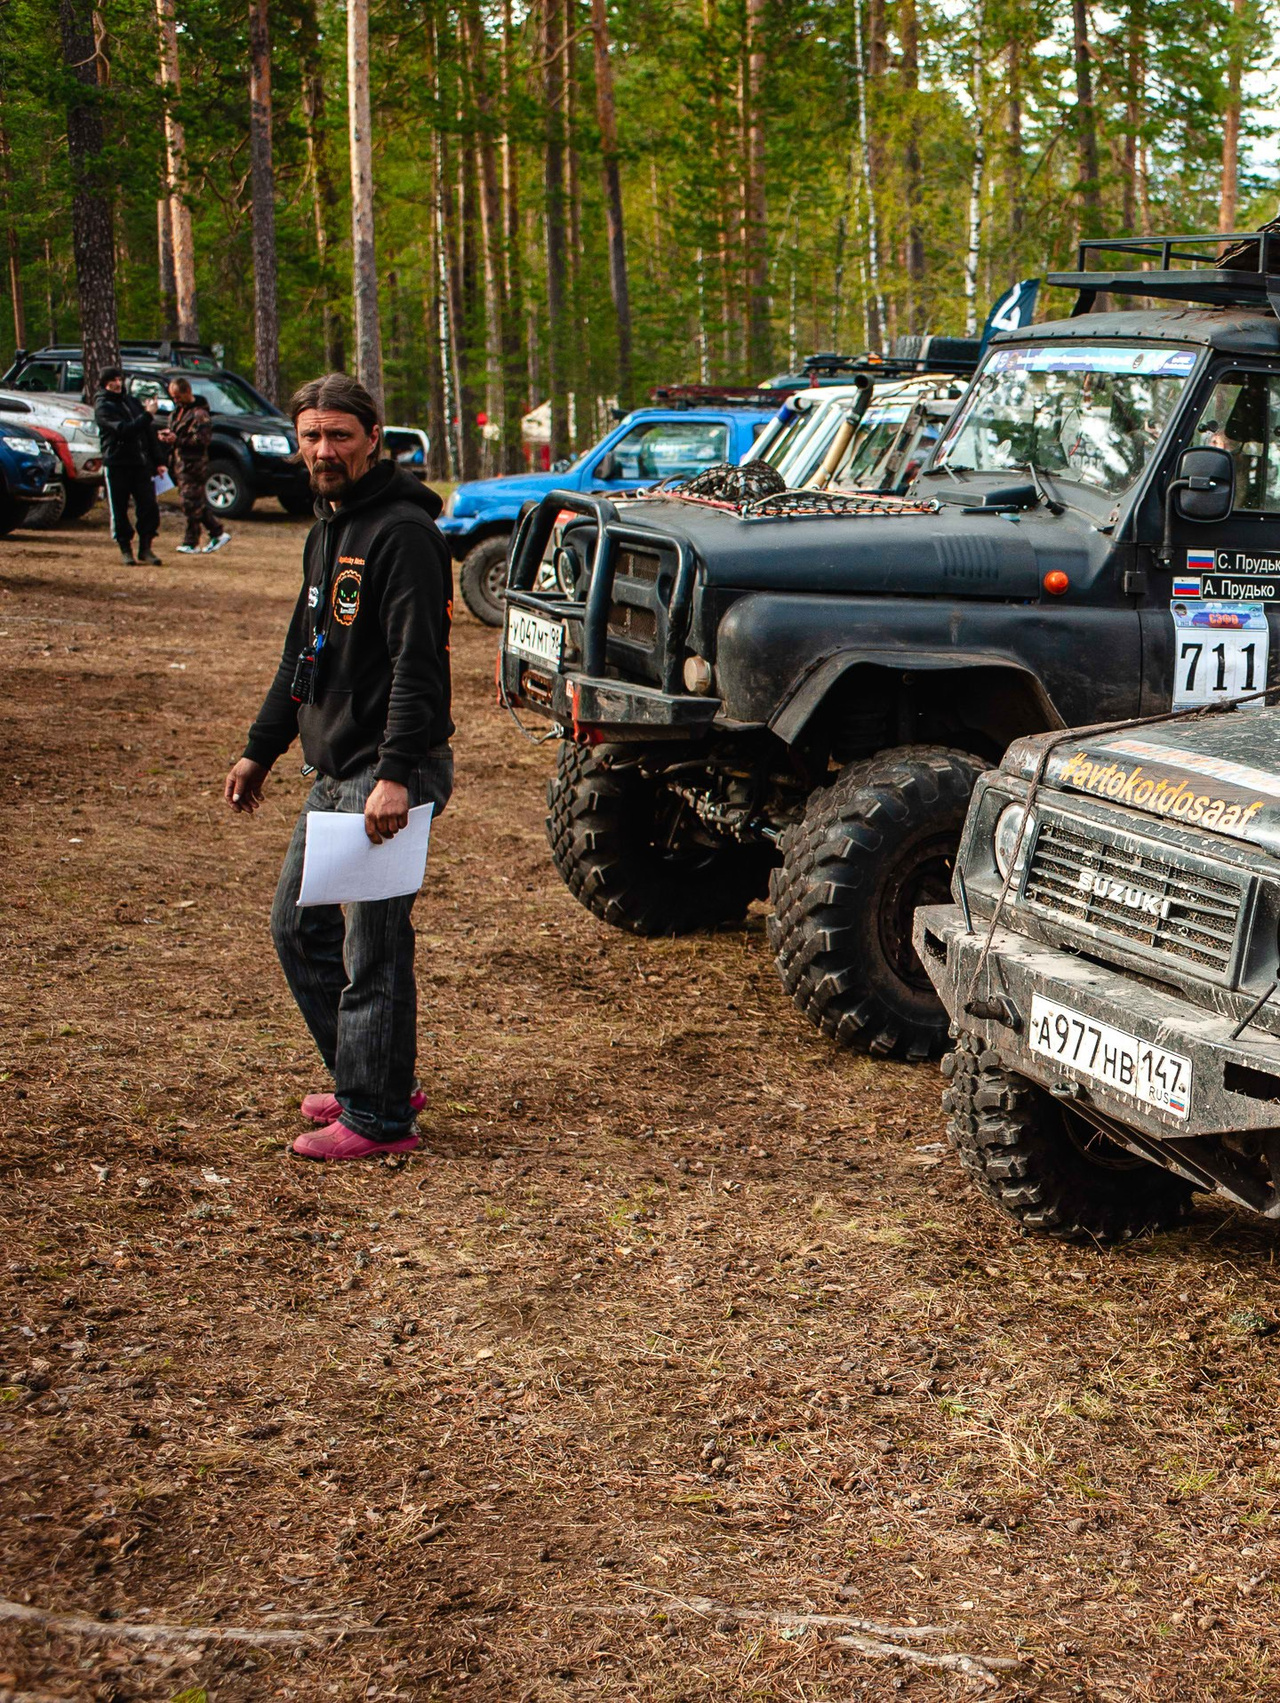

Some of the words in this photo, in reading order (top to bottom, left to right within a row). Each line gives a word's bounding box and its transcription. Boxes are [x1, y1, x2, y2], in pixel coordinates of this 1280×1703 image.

[1217, 553, 1232, 570] С.
[1204, 579, 1218, 596] А.
[1221, 580, 1275, 599] Прудько
[1181, 643, 1257, 691] 711
[1059, 752, 1265, 834] #avtokotdosaaf
[1078, 872, 1172, 919] SUZUKI
[1149, 1086, 1170, 1105] RUS
